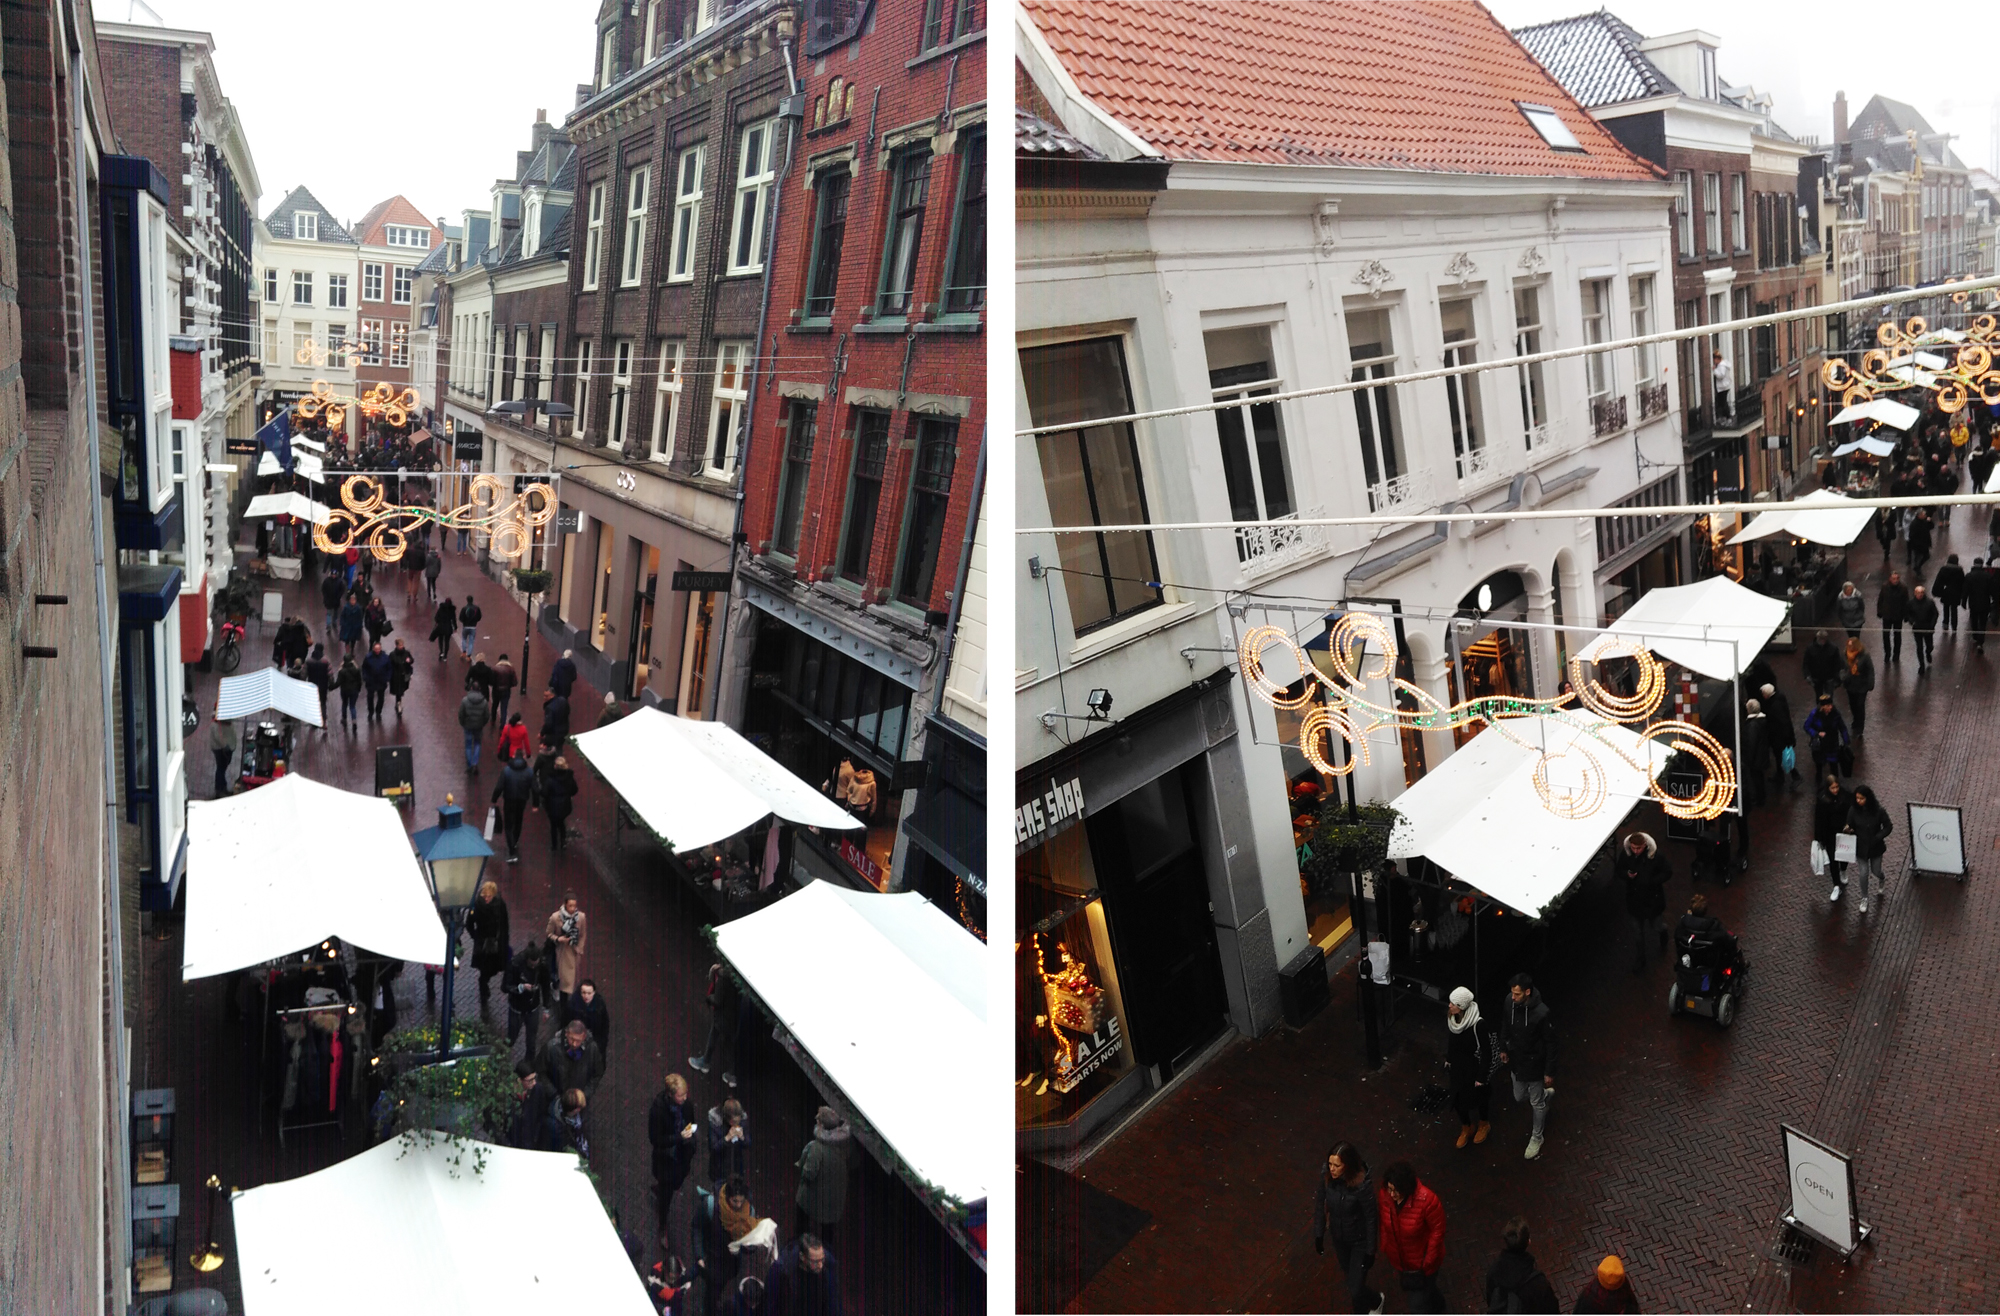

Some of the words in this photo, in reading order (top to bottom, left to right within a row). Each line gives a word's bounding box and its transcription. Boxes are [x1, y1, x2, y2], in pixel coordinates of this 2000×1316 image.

[617, 470, 635, 491] COS
[557, 517, 577, 526] COS
[1670, 782, 1698, 798] SALE
[1015, 798, 1047, 845] ens
[1045, 777, 1085, 826] shop
[1924, 832, 1949, 843] OPEN
[847, 844, 876, 880] SALE
[1060, 1016, 1120, 1076] SALE
[1066, 1058, 1100, 1089] STARTS
[1100, 1039, 1123, 1064] NOW
[1804, 1177, 1834, 1200] OPEN
